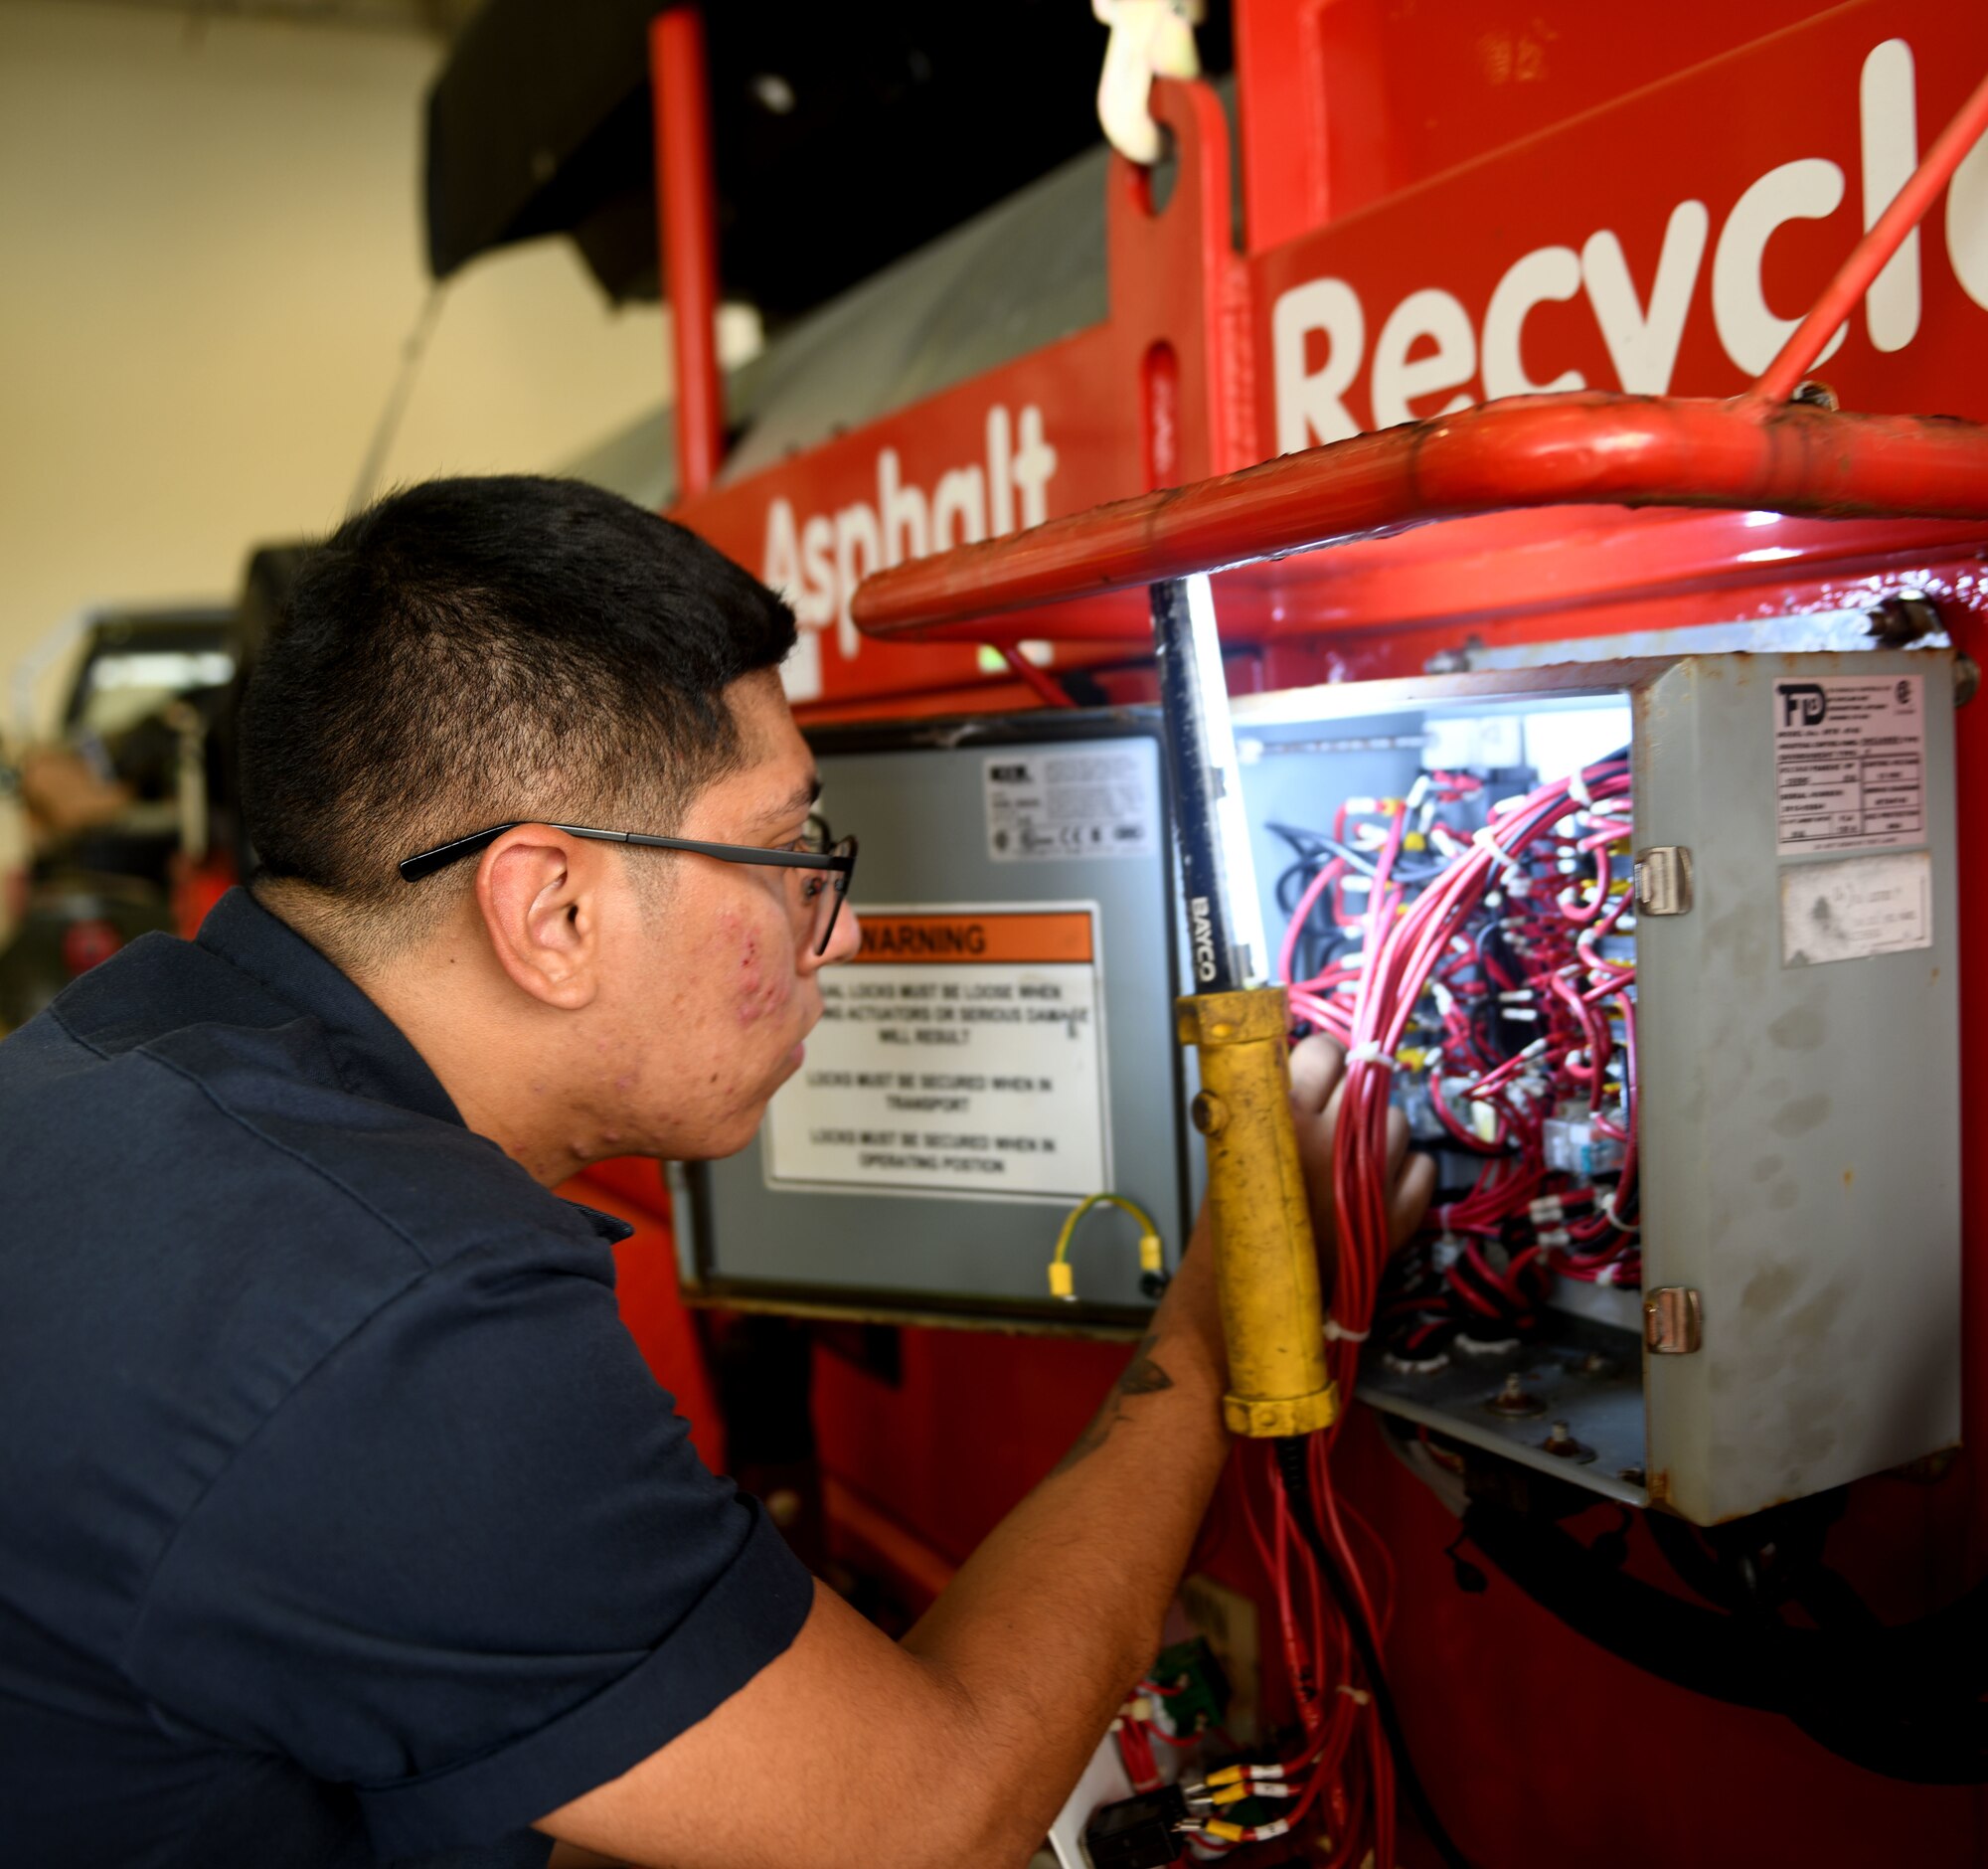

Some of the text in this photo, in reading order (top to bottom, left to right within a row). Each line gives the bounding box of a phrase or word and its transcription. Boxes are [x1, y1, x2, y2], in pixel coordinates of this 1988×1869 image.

[762, 403, 1057, 660] Asphalt
[1192, 896, 1217, 983] BAYCO
[900, 983, 938, 998] MUST
[942, 983, 960, 998] BE
[965, 983, 1014, 998] LOOSE
[1019, 982, 1062, 998] WHEN
[848, 1007, 930, 1022] ACTUATORS
[959, 1007, 1021, 1022] SERIOUS
[879, 1029, 970, 1045] WILL RESULT
[857, 1072, 894, 1089] MUST
[898, 1073, 914, 1090] BE
[920, 1074, 985, 1091] SECURED
[992, 1076, 1034, 1093] WHEN
[886, 1097, 969, 1113] TRANSPORT
[860, 1130, 898, 1146] MUST
[901, 1131, 920, 1148] BE
[923, 1132, 989, 1150] SECURED
[995, 1135, 1038, 1152] WHEN
[859, 1152, 937, 1171] OPERATING
